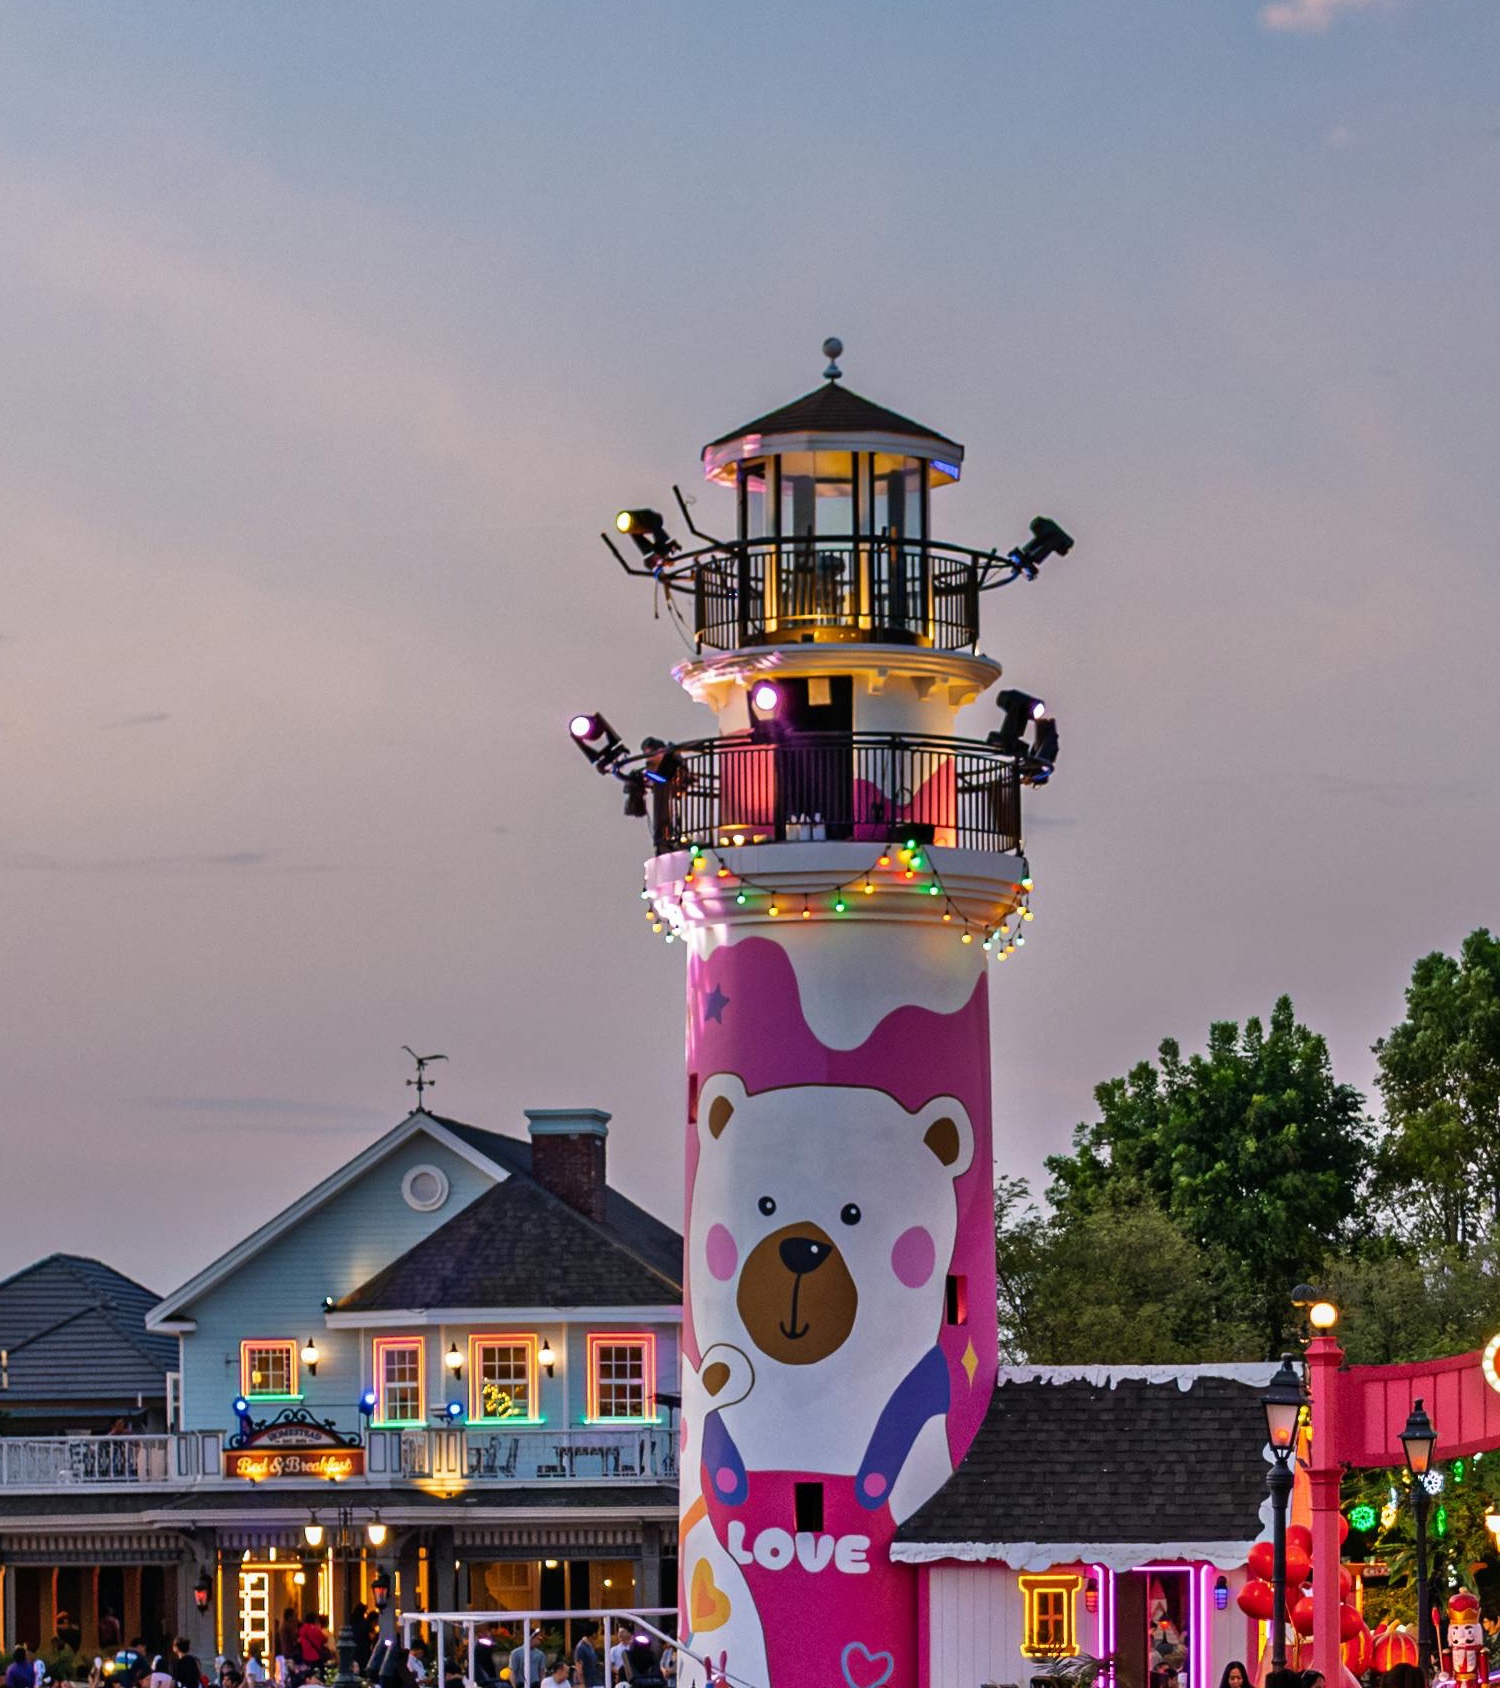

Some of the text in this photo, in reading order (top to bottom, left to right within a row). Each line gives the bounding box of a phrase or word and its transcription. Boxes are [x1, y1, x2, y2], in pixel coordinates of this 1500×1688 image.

[236, 1456, 268, 1474] Bed
[285, 1456, 353, 1474] Breakfast
[727, 1519, 871, 1574] LOVE
